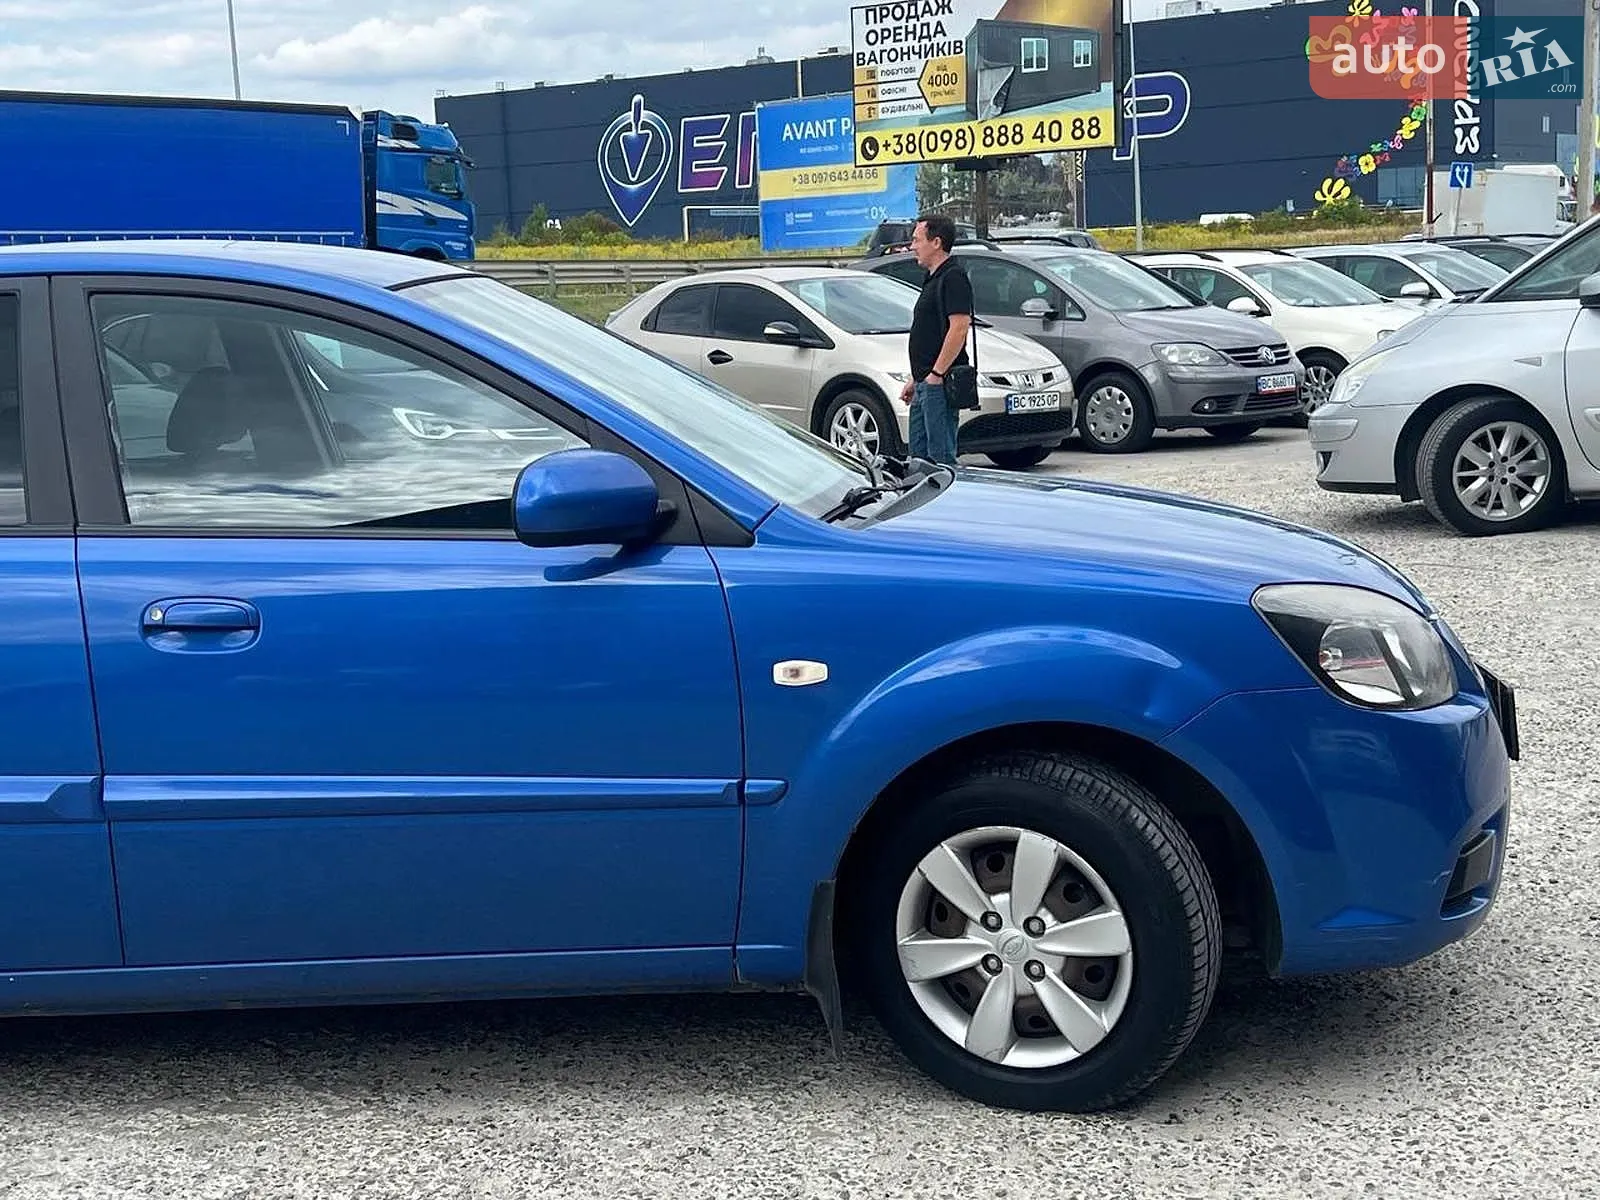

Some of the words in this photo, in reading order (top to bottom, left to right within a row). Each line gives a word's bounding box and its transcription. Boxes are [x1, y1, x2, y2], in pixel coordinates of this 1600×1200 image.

[865, 0, 953, 25] ПРОДАЖ
[865, 20, 947, 46] ОРЕНДА
[856, 40, 964, 67] ВАГОНЧИКІВ
[880, 66, 916, 77] ПОБУТОВІ
[928, 72, 958, 88] 4000
[880, 87, 907, 96] ОФІСНІ
[880, 103, 924, 114] БУДІВЕЛЬНІ
[782, 118, 838, 142] AVANT
[982, 123, 1024, 148] 888
[1032, 120, 1062, 143] 40
[1071, 116, 1101, 140] 88
[1013, 396, 1027, 408] BC
[1028, 394, 1046, 407] 1925
[1047, 394, 1058, 406] OP
